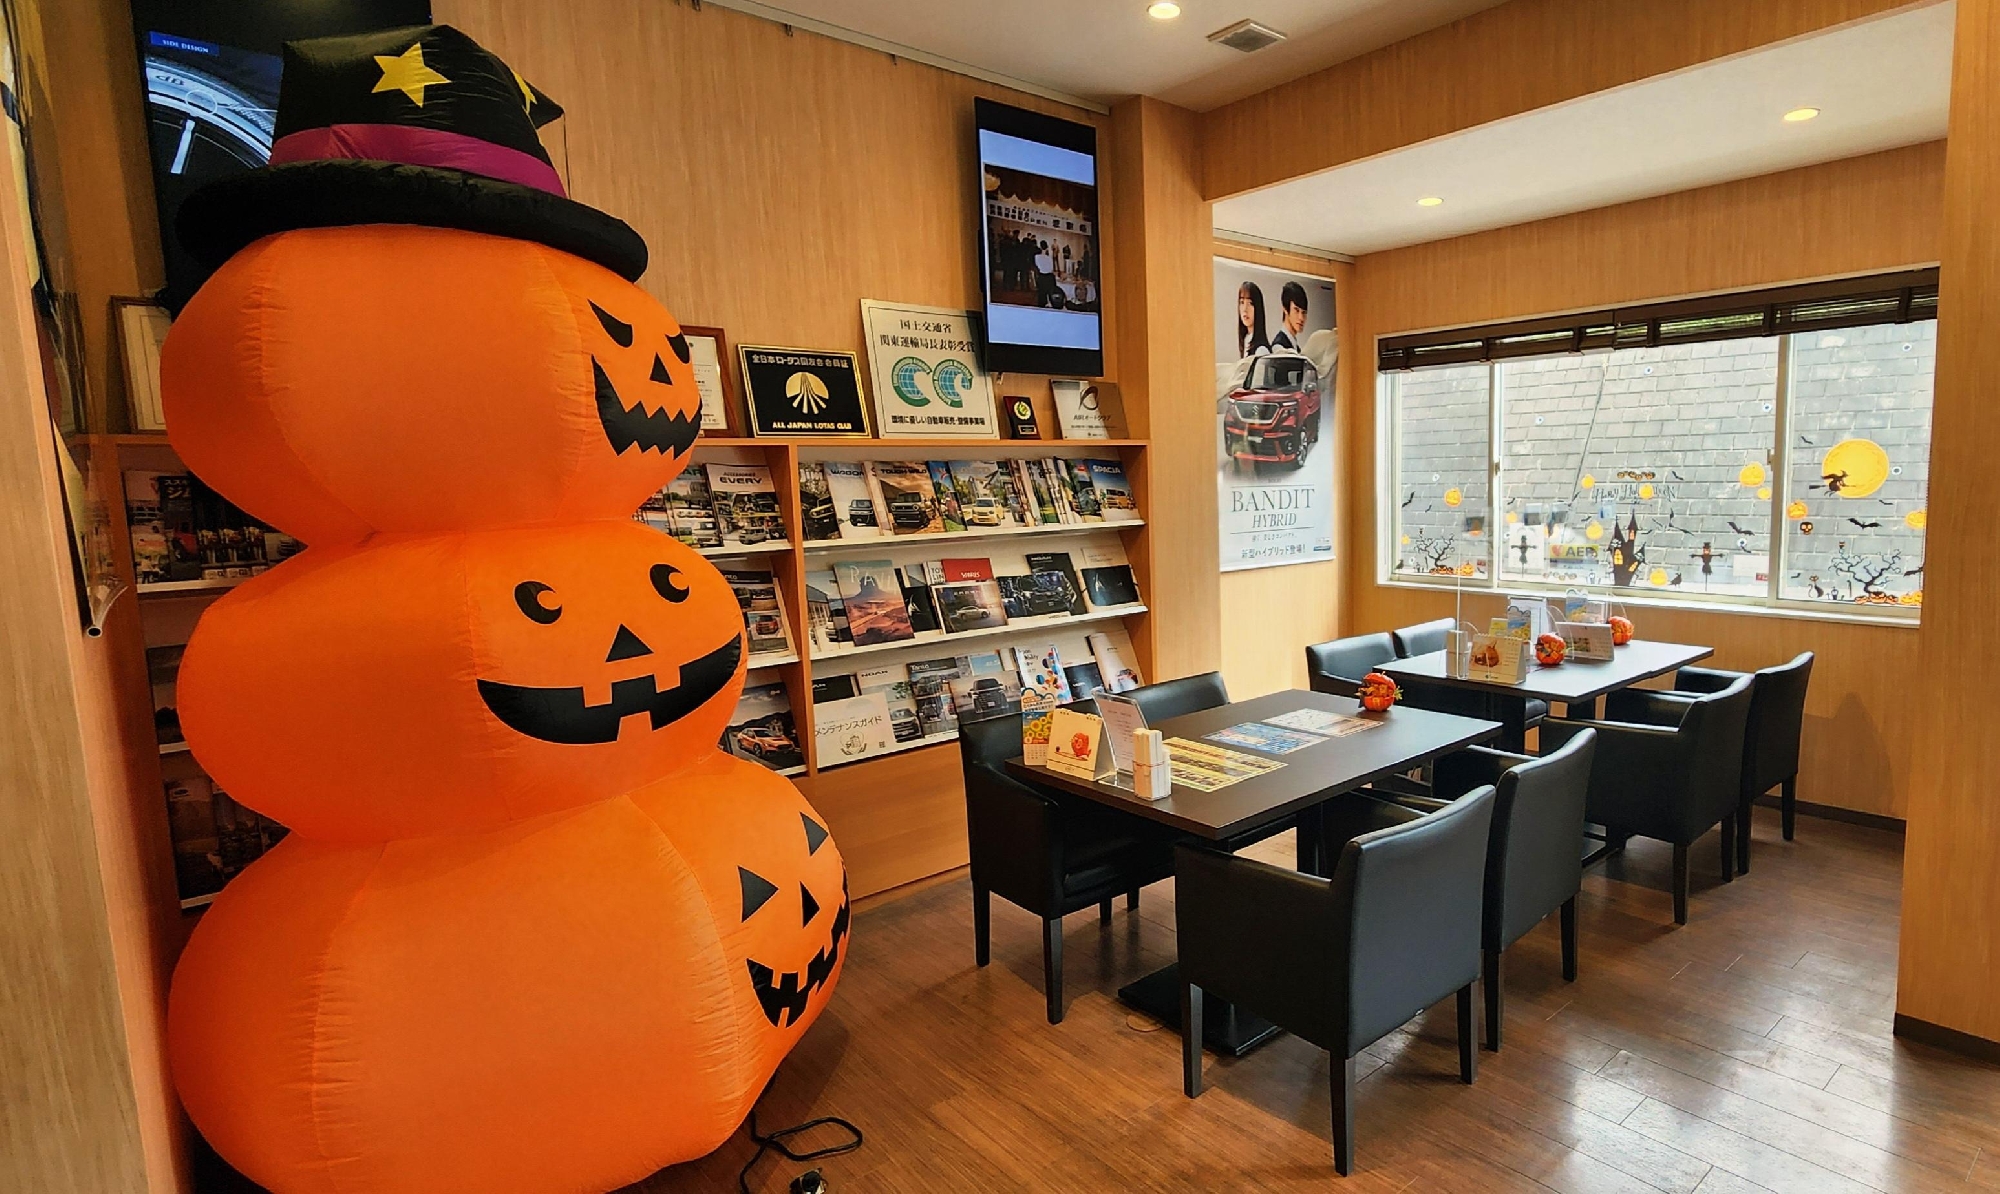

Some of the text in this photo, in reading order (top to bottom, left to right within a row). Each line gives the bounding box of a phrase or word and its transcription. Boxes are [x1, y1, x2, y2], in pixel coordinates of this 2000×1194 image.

[900, 319, 952, 334] 国土交通省
[772, 421, 786, 429] ALL
[1092, 464, 1122, 474] SPACIA
[720, 477, 762, 485] EVERY
[1231, 488, 1315, 513] BANDIT
[1252, 513, 1297, 529] HYBRID
[814, 715, 883, 737] メンテナンスガイド
